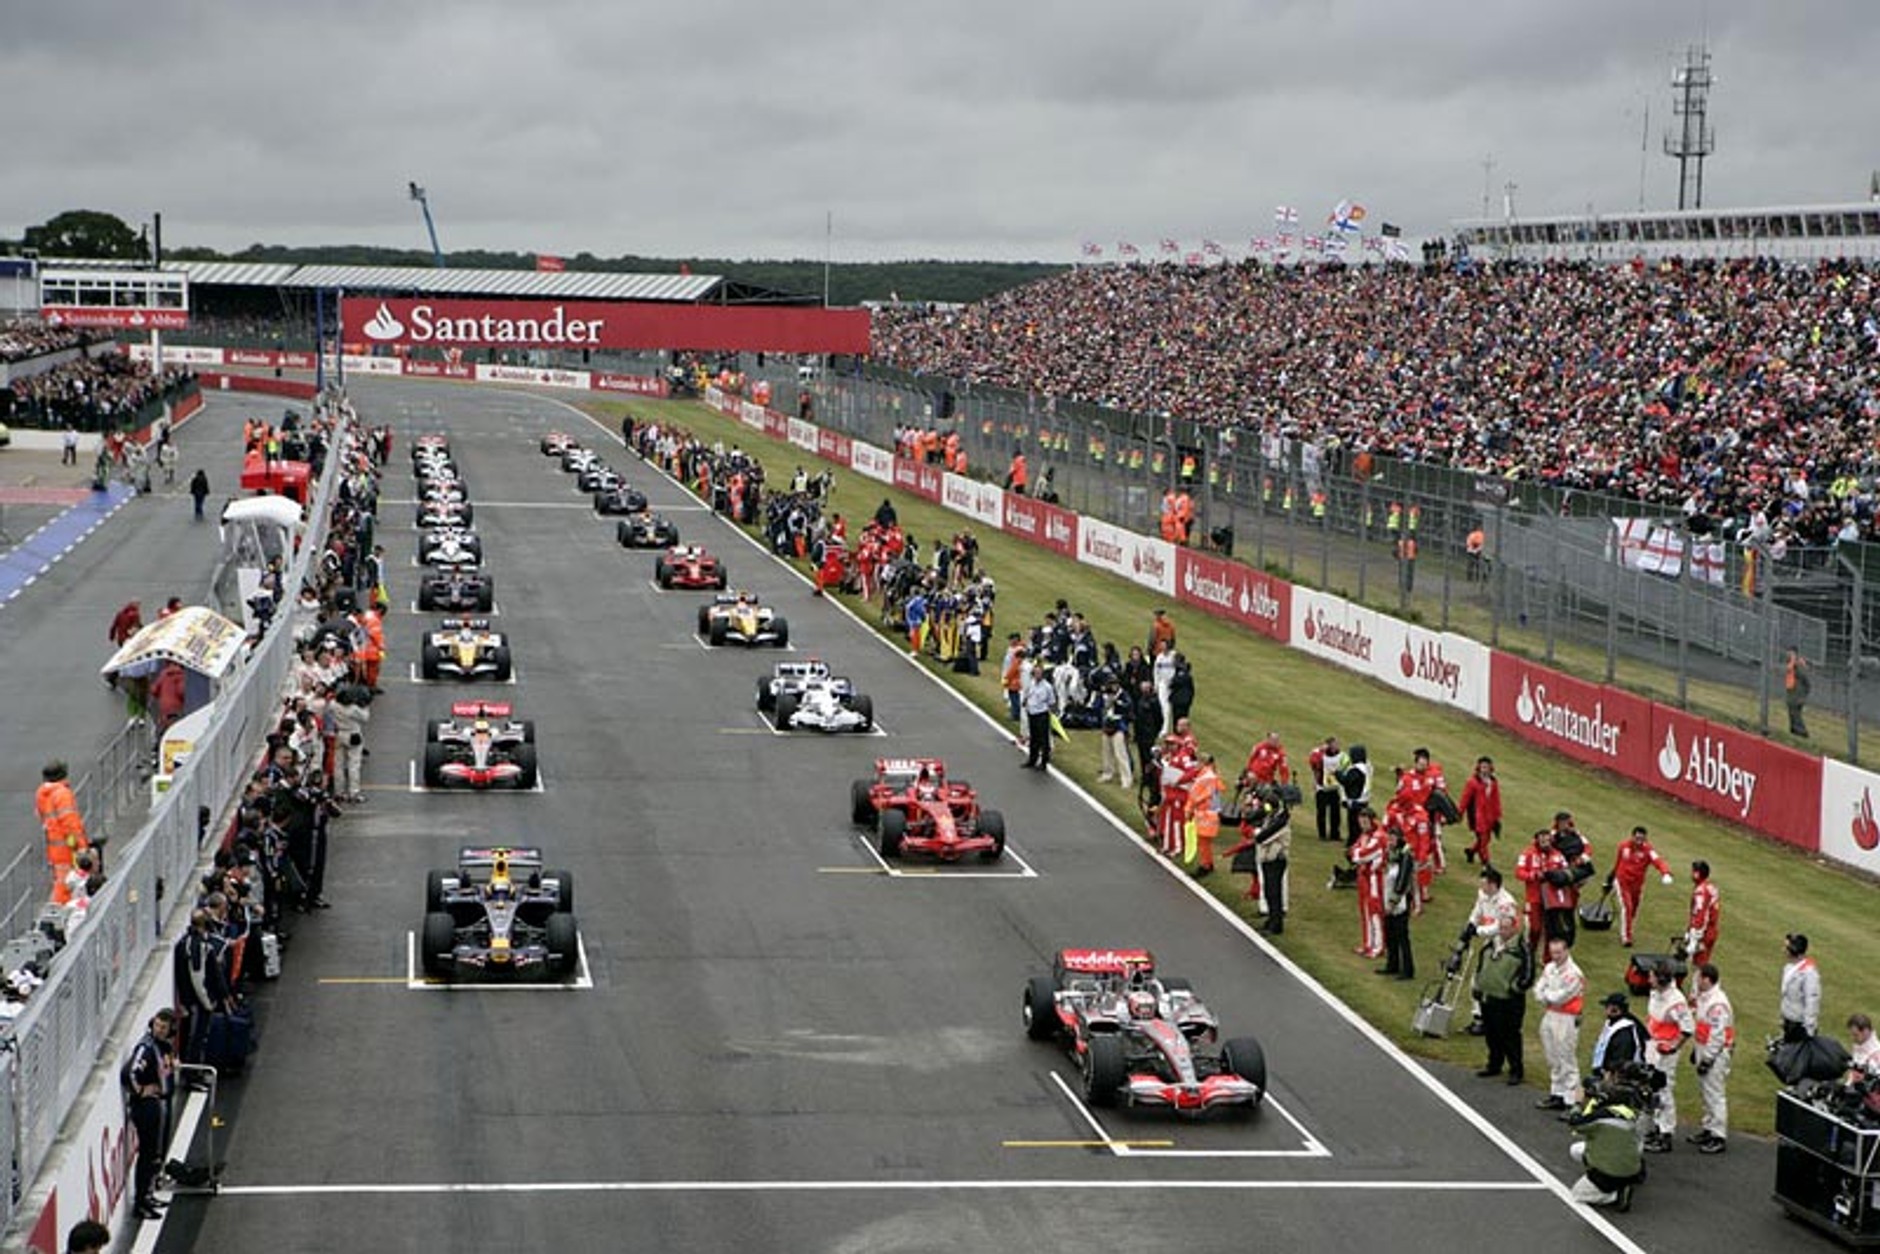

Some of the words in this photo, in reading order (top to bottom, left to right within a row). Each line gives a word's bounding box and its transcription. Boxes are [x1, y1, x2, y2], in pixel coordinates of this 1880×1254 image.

[411, 304, 603, 343] Santander
[1316, 598, 1373, 663] Santander
[1417, 640, 1460, 699] Abbey
[1534, 684, 1622, 756] Santander
[1685, 735, 1757, 818] Abbey
[1065, 951, 1149, 966] vodafo
